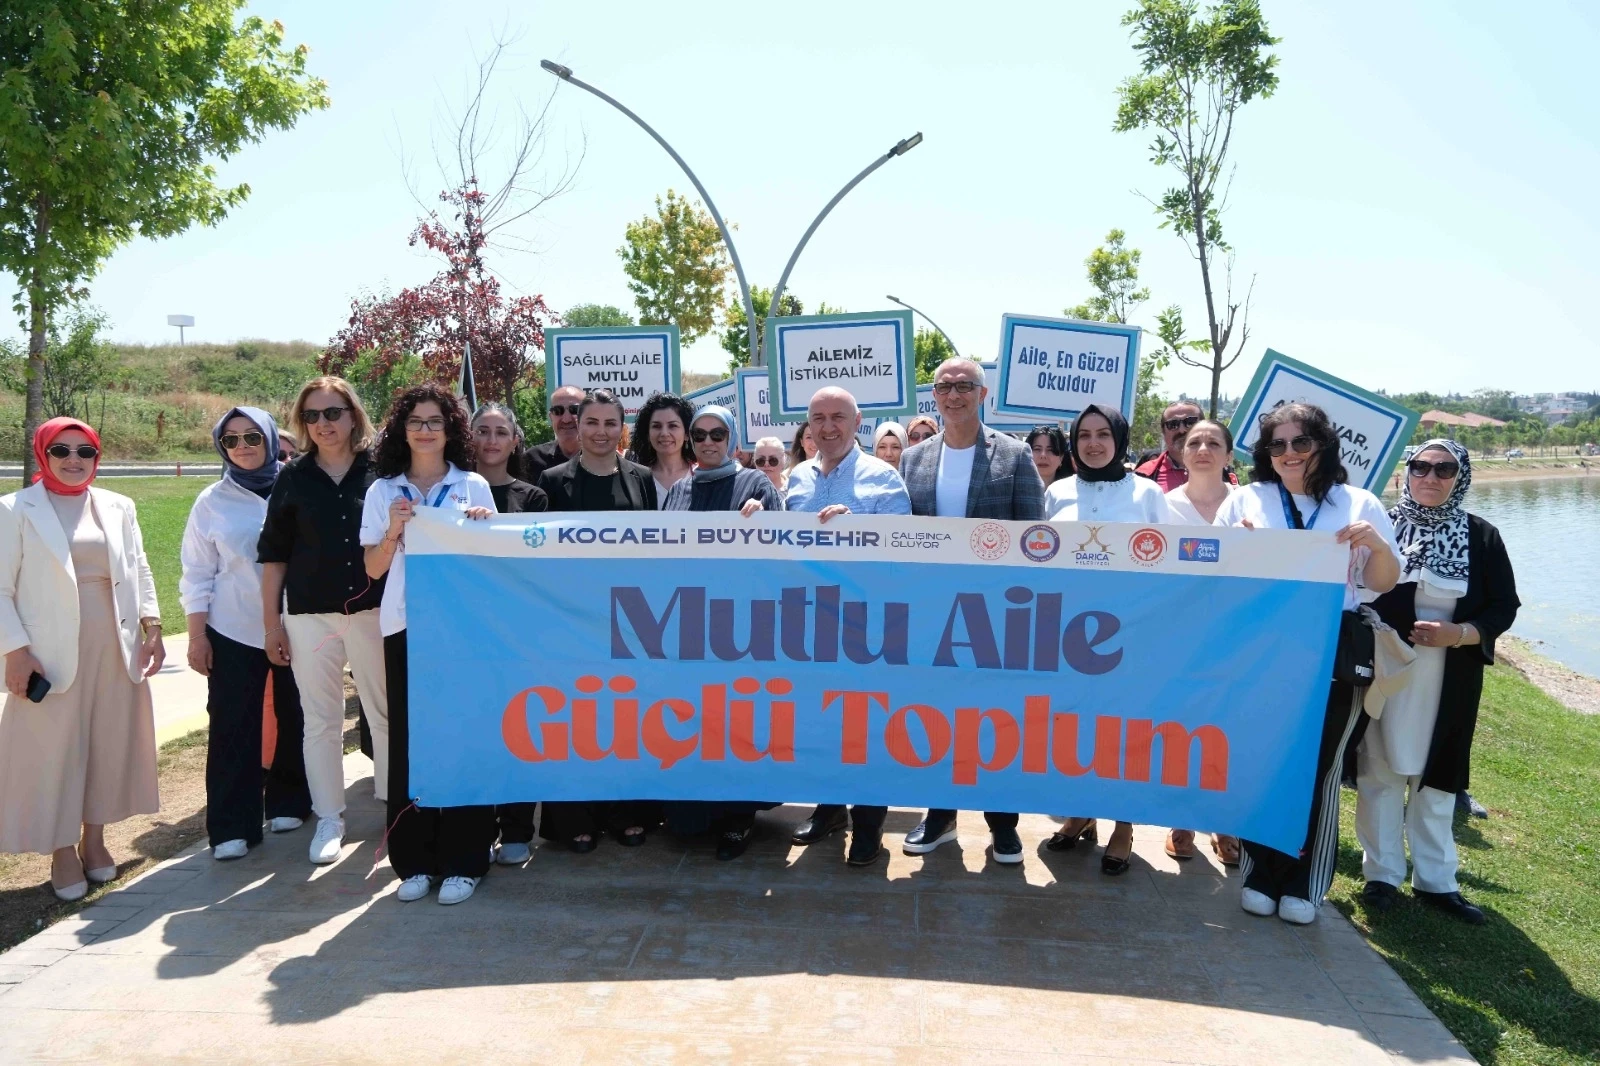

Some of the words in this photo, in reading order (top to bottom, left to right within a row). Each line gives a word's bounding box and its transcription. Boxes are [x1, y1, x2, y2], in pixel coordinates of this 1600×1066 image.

[563, 353, 626, 366] SAĞLIKLI
[630, 351, 661, 365] AİLE
[807, 345, 873, 362] AİLEMİZ
[1018, 346, 1051, 370] Aile,
[1056, 350, 1073, 369] En
[1078, 352, 1119, 373] Güzel
[588, 371, 638, 382] MUTLU
[790, 362, 893, 380] İSTİKBALİMİZ
[1037, 371, 1097, 394] Okuldur
[890, 540, 940, 549] OLUYOR
[1075, 552, 1110, 561] DARICA
[610, 585, 910, 665] Mutlu
[932, 586, 1124, 675] Aile
[501, 674, 795, 770] Güçlü
[822, 690, 1230, 792] Toplum
